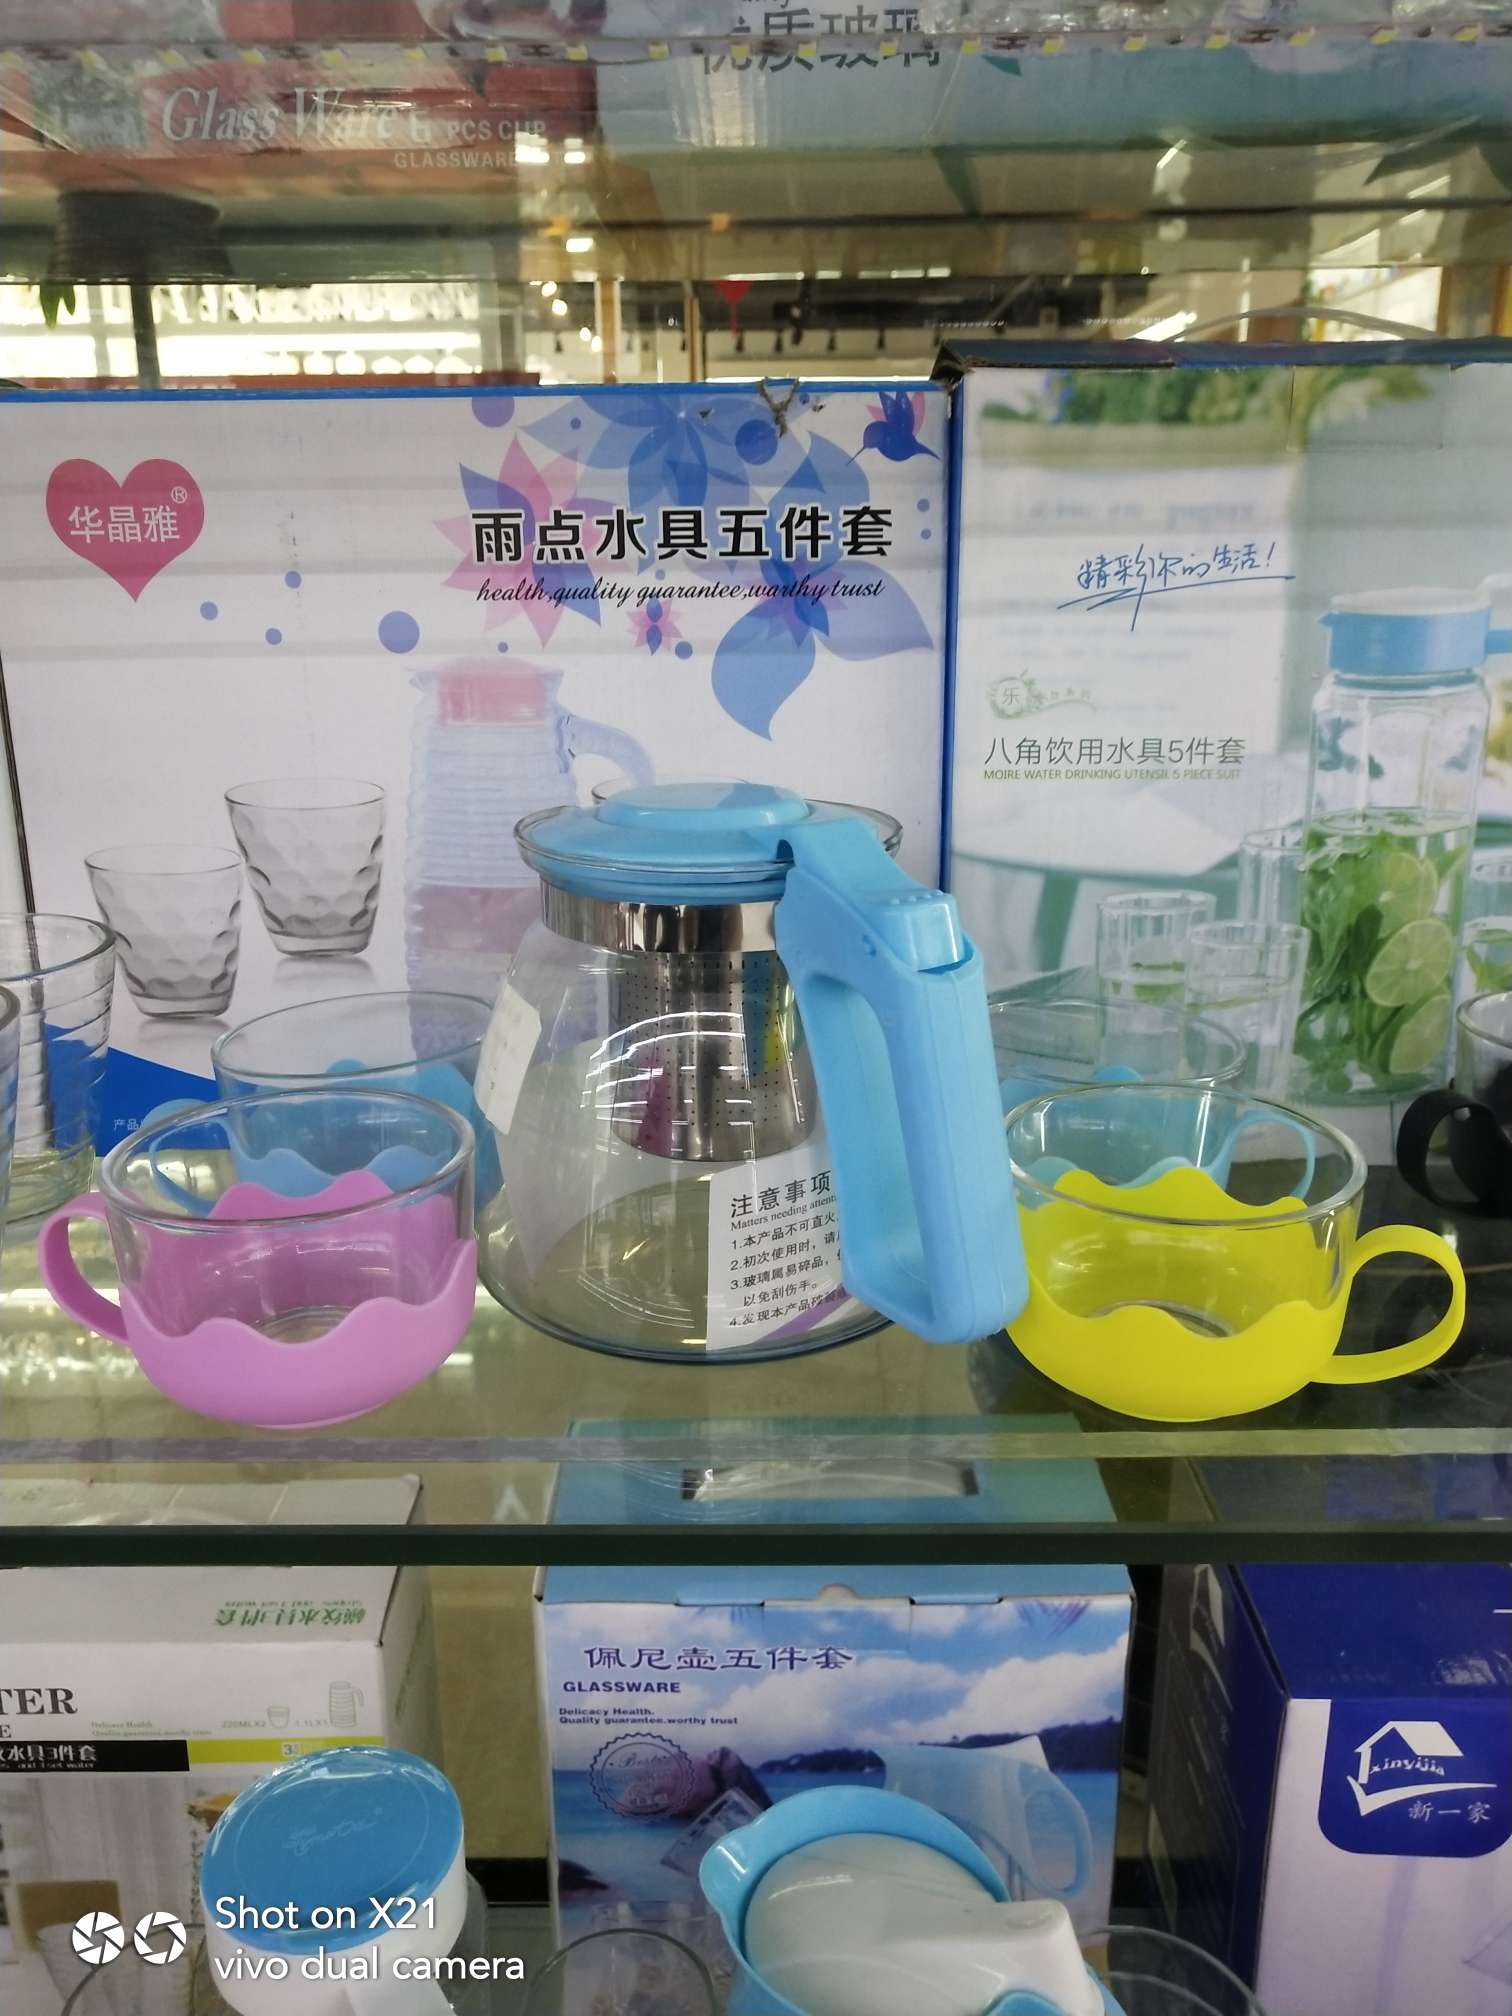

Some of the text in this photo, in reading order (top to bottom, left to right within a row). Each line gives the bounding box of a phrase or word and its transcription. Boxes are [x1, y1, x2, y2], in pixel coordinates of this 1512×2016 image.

[162, 87, 279, 142] Glass
[68, 504, 181, 544] 华晶雅
[471, 505, 893, 563] 雨点水具五件套
[831, 578, 886, 598] trust
[983, 736, 1246, 766] 八角饮用水具5件套
[1023, 768, 1062, 780] WATER
[1064, 768, 1121, 780] DRINKING
[1183, 768, 1214, 780] PIECE
[731, 1169, 832, 1218] 注意事项
[730, 1215, 769, 1232] Matters
[770, 1203, 808, 1221] needing
[584, 1645, 853, 1671] 佩尼壶五件套
[563, 1681, 681, 1693] GLASSWARE
[559, 1707, 609, 1717] Delicacy
[559, 1716, 601, 1726] Quality
[710, 1716, 739, 1725] trust
[1408, 1800, 1491, 1824] 新一家
